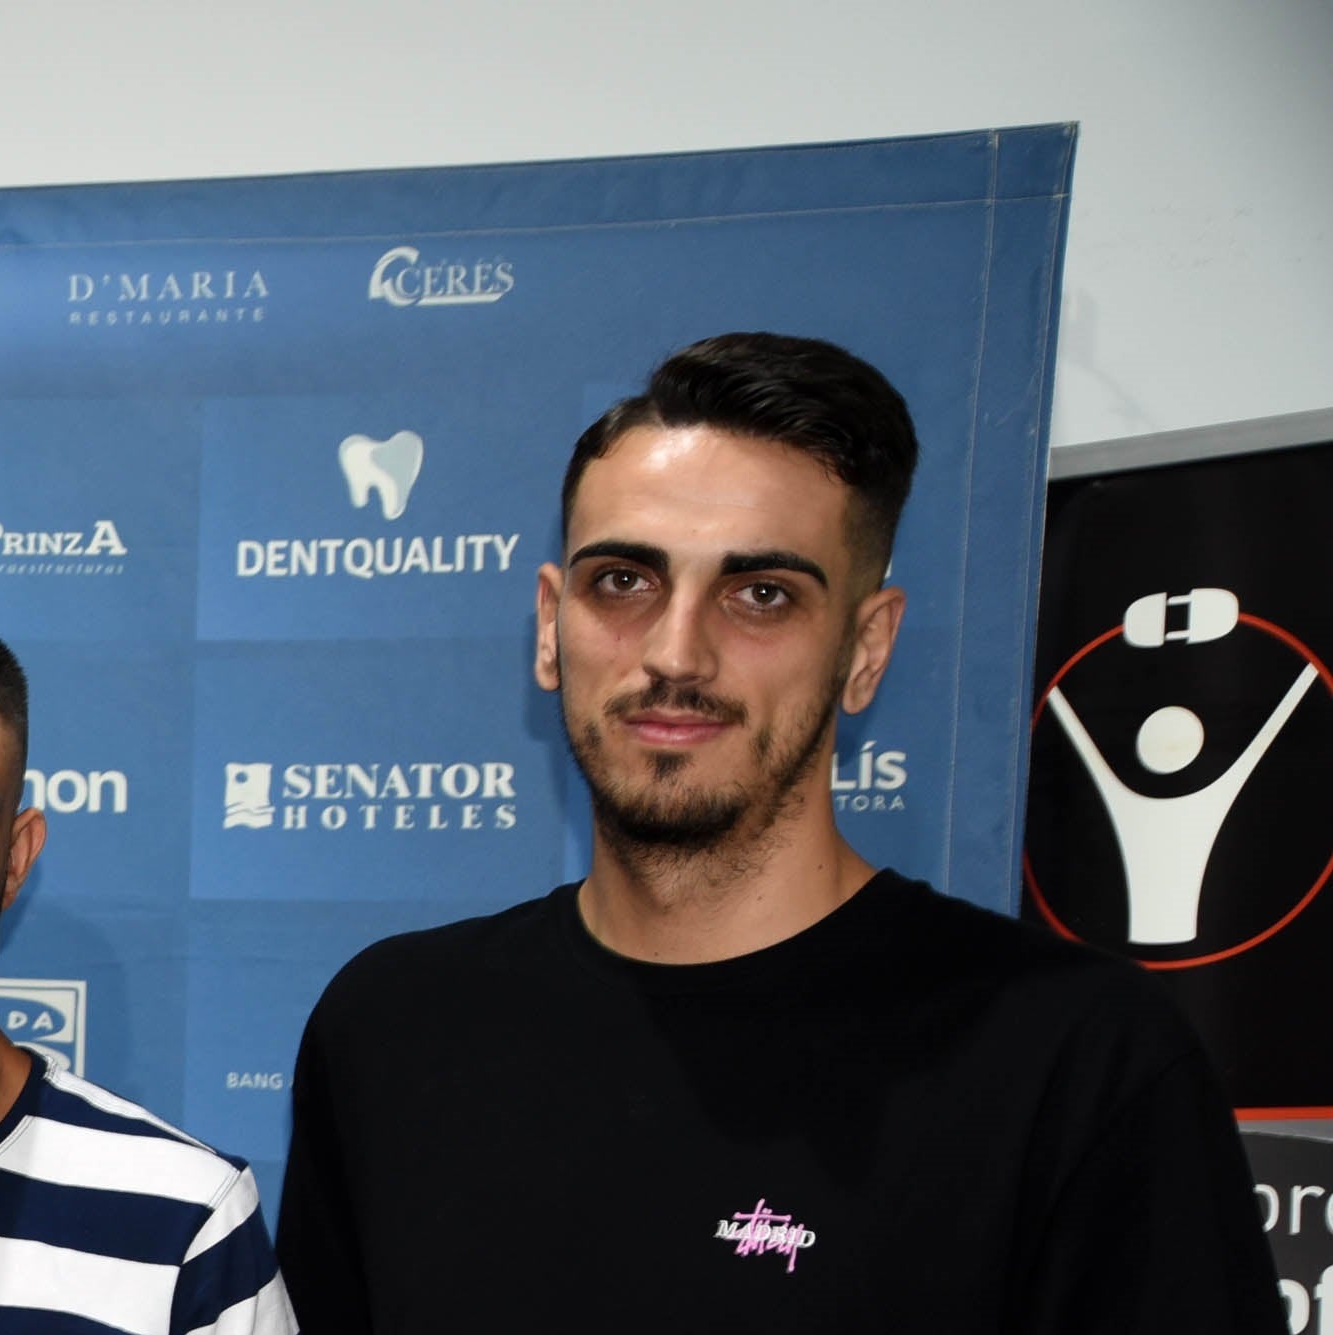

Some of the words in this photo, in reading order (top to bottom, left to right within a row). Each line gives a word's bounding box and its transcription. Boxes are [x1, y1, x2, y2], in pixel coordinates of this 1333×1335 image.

[68, 306, 266, 325] RESTAURANTE
[236, 534, 519, 580] DENTQUALITY
[282, 762, 517, 798] SENATOR
[283, 803, 517, 830] HOTELES
[226, 1072, 284, 1090] BANG
